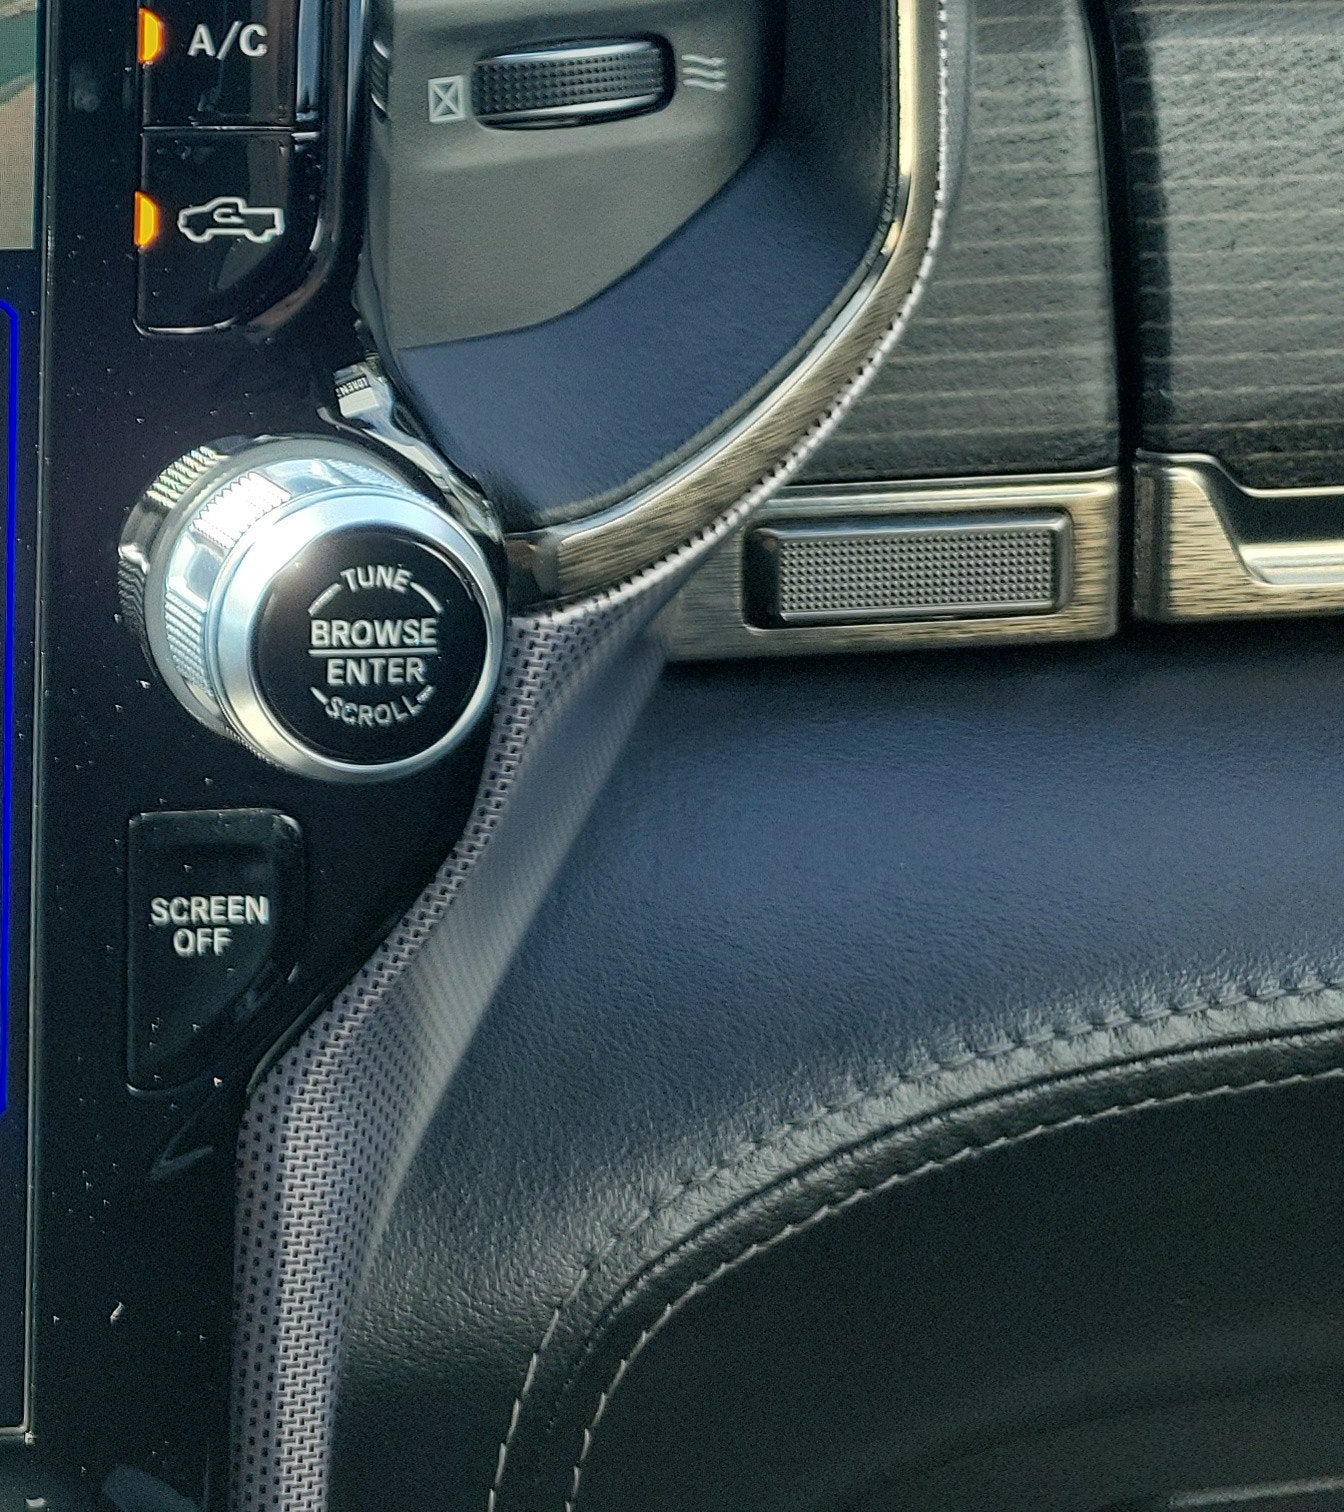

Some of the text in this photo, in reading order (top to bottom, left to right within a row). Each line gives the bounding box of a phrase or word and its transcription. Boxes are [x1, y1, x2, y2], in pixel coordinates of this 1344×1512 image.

[186, 22, 269, 61] A/C
[340, 562, 414, 594] TUNE
[310, 618, 439, 651] BROWSE
[325, 656, 427, 687] ENTER
[324, 695, 422, 728] SCROLL
[151, 896, 269, 926] SCREEN
[173, 928, 232, 958] OFF
